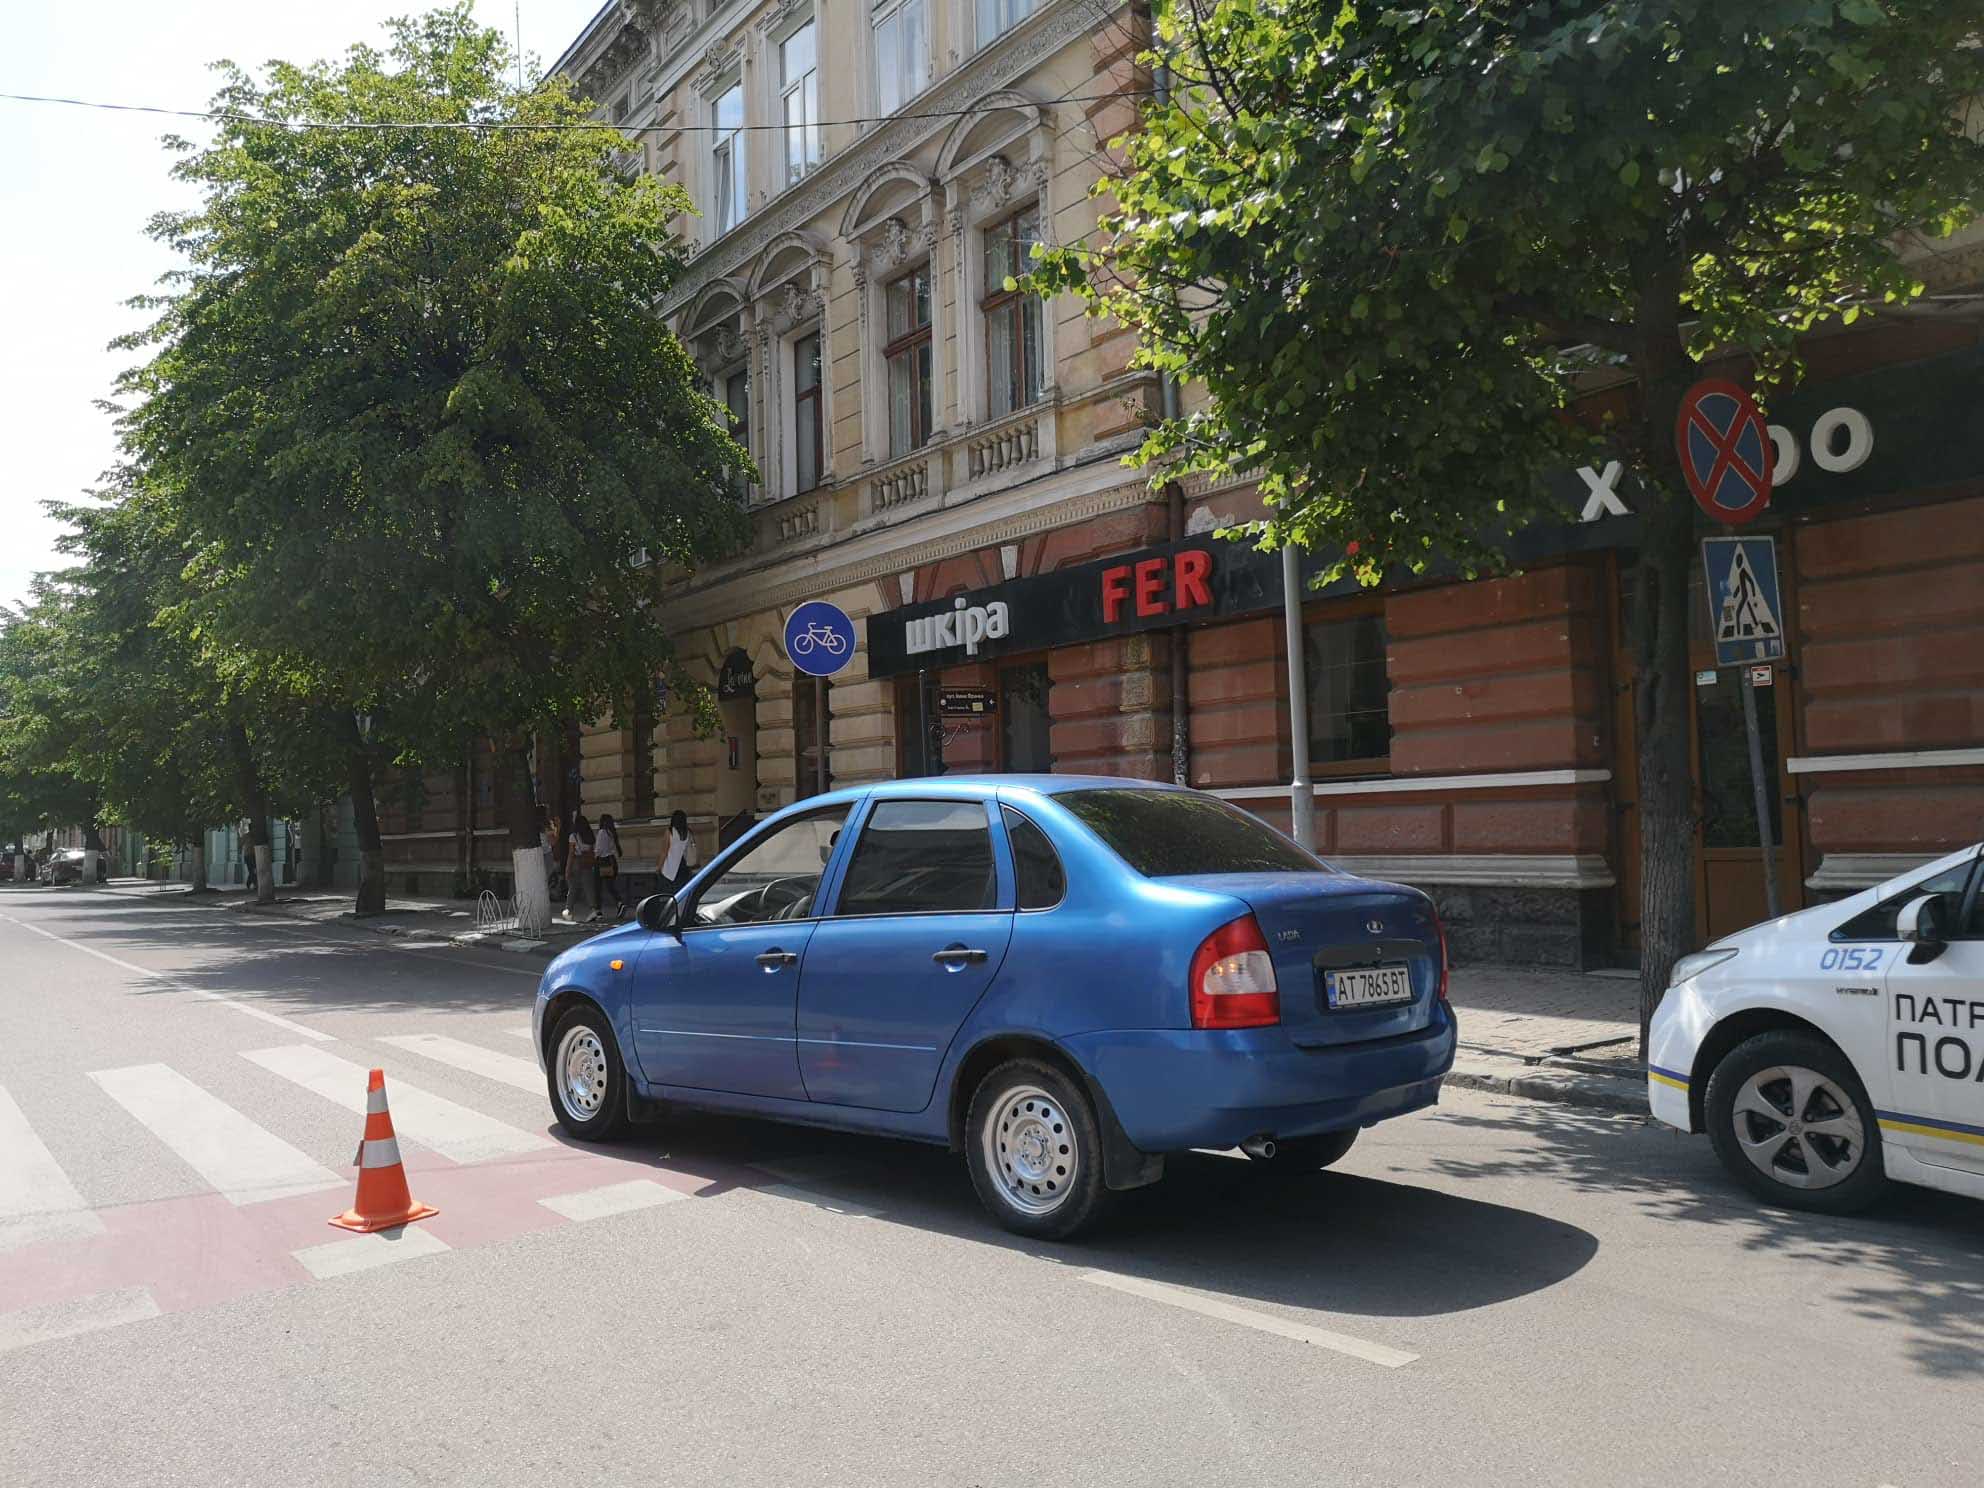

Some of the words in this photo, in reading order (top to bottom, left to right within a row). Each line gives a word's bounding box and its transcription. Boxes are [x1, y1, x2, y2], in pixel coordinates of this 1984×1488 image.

[1102, 550, 1213, 624] FER
[905, 597, 1010, 656] шкіра
[1820, 948, 1883, 971] 0152
